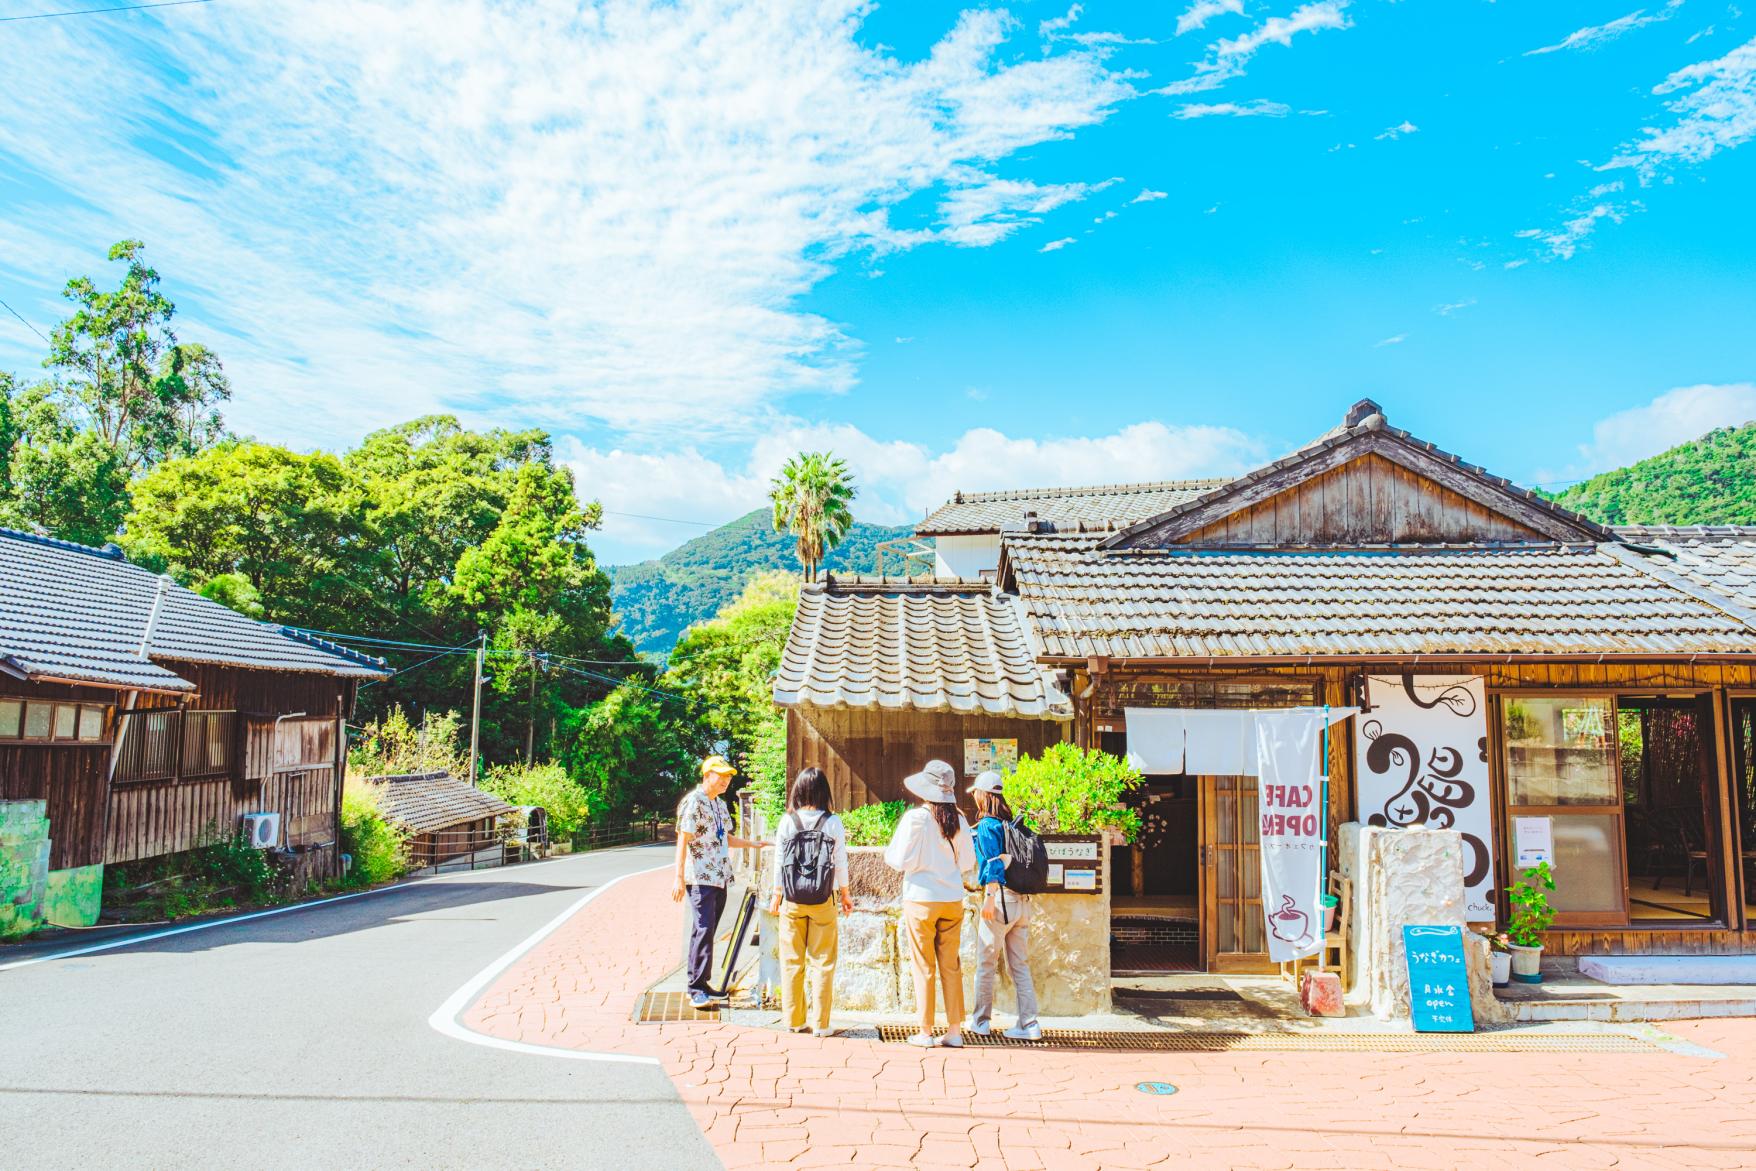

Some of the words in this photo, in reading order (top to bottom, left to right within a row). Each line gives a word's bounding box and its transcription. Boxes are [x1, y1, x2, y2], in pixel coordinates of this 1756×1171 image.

[1411, 950, 1461, 964] うなぎカフェ
[1426, 1000, 1454, 1010] open
